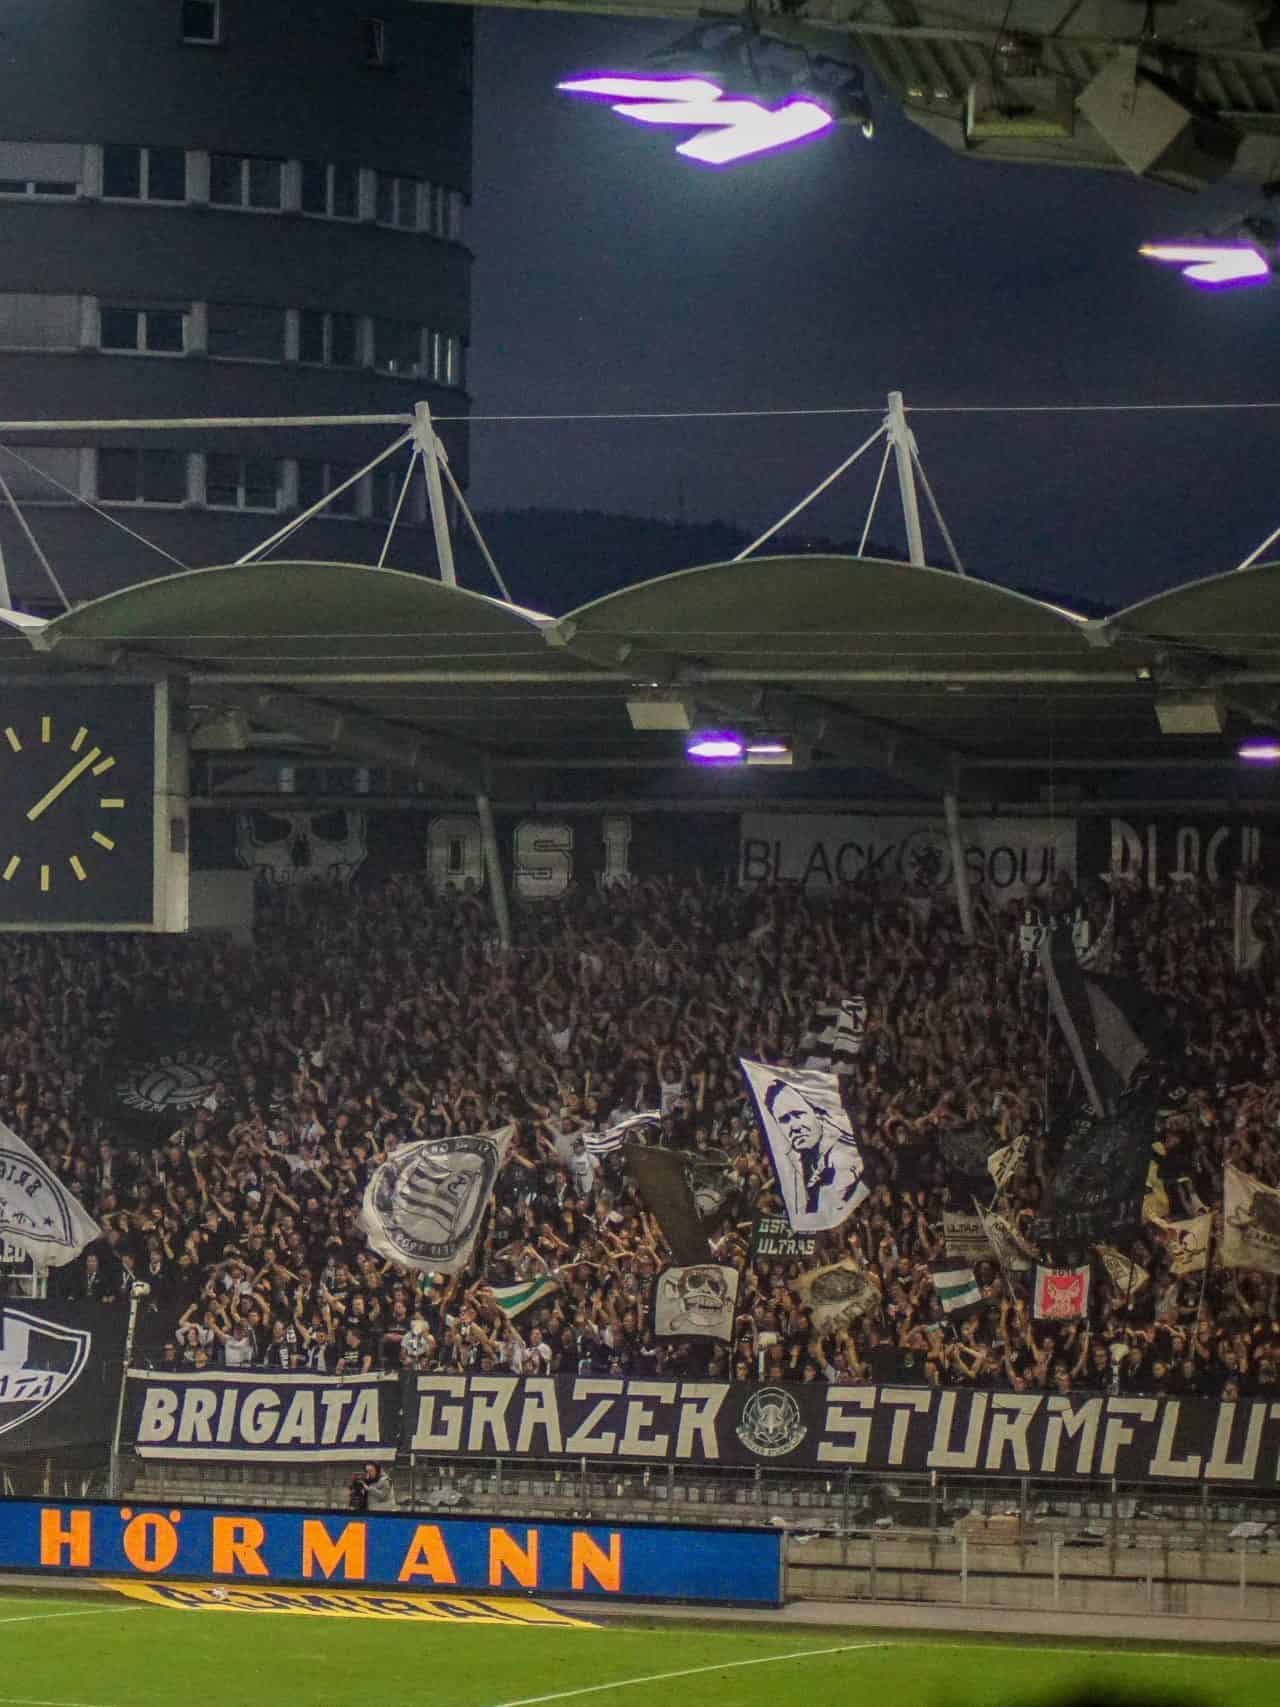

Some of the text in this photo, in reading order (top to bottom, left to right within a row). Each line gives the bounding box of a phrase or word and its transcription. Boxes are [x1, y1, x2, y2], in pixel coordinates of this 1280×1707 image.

[742, 840, 895, 888] BLACK
[757, 1238, 816, 1256] ULTRAS
[137, 1388, 380, 1446] BRIGATA
[411, 1376, 1280, 1481] GRAZER STURMFLU
[39, 1506, 621, 1592] HÖRMANN
